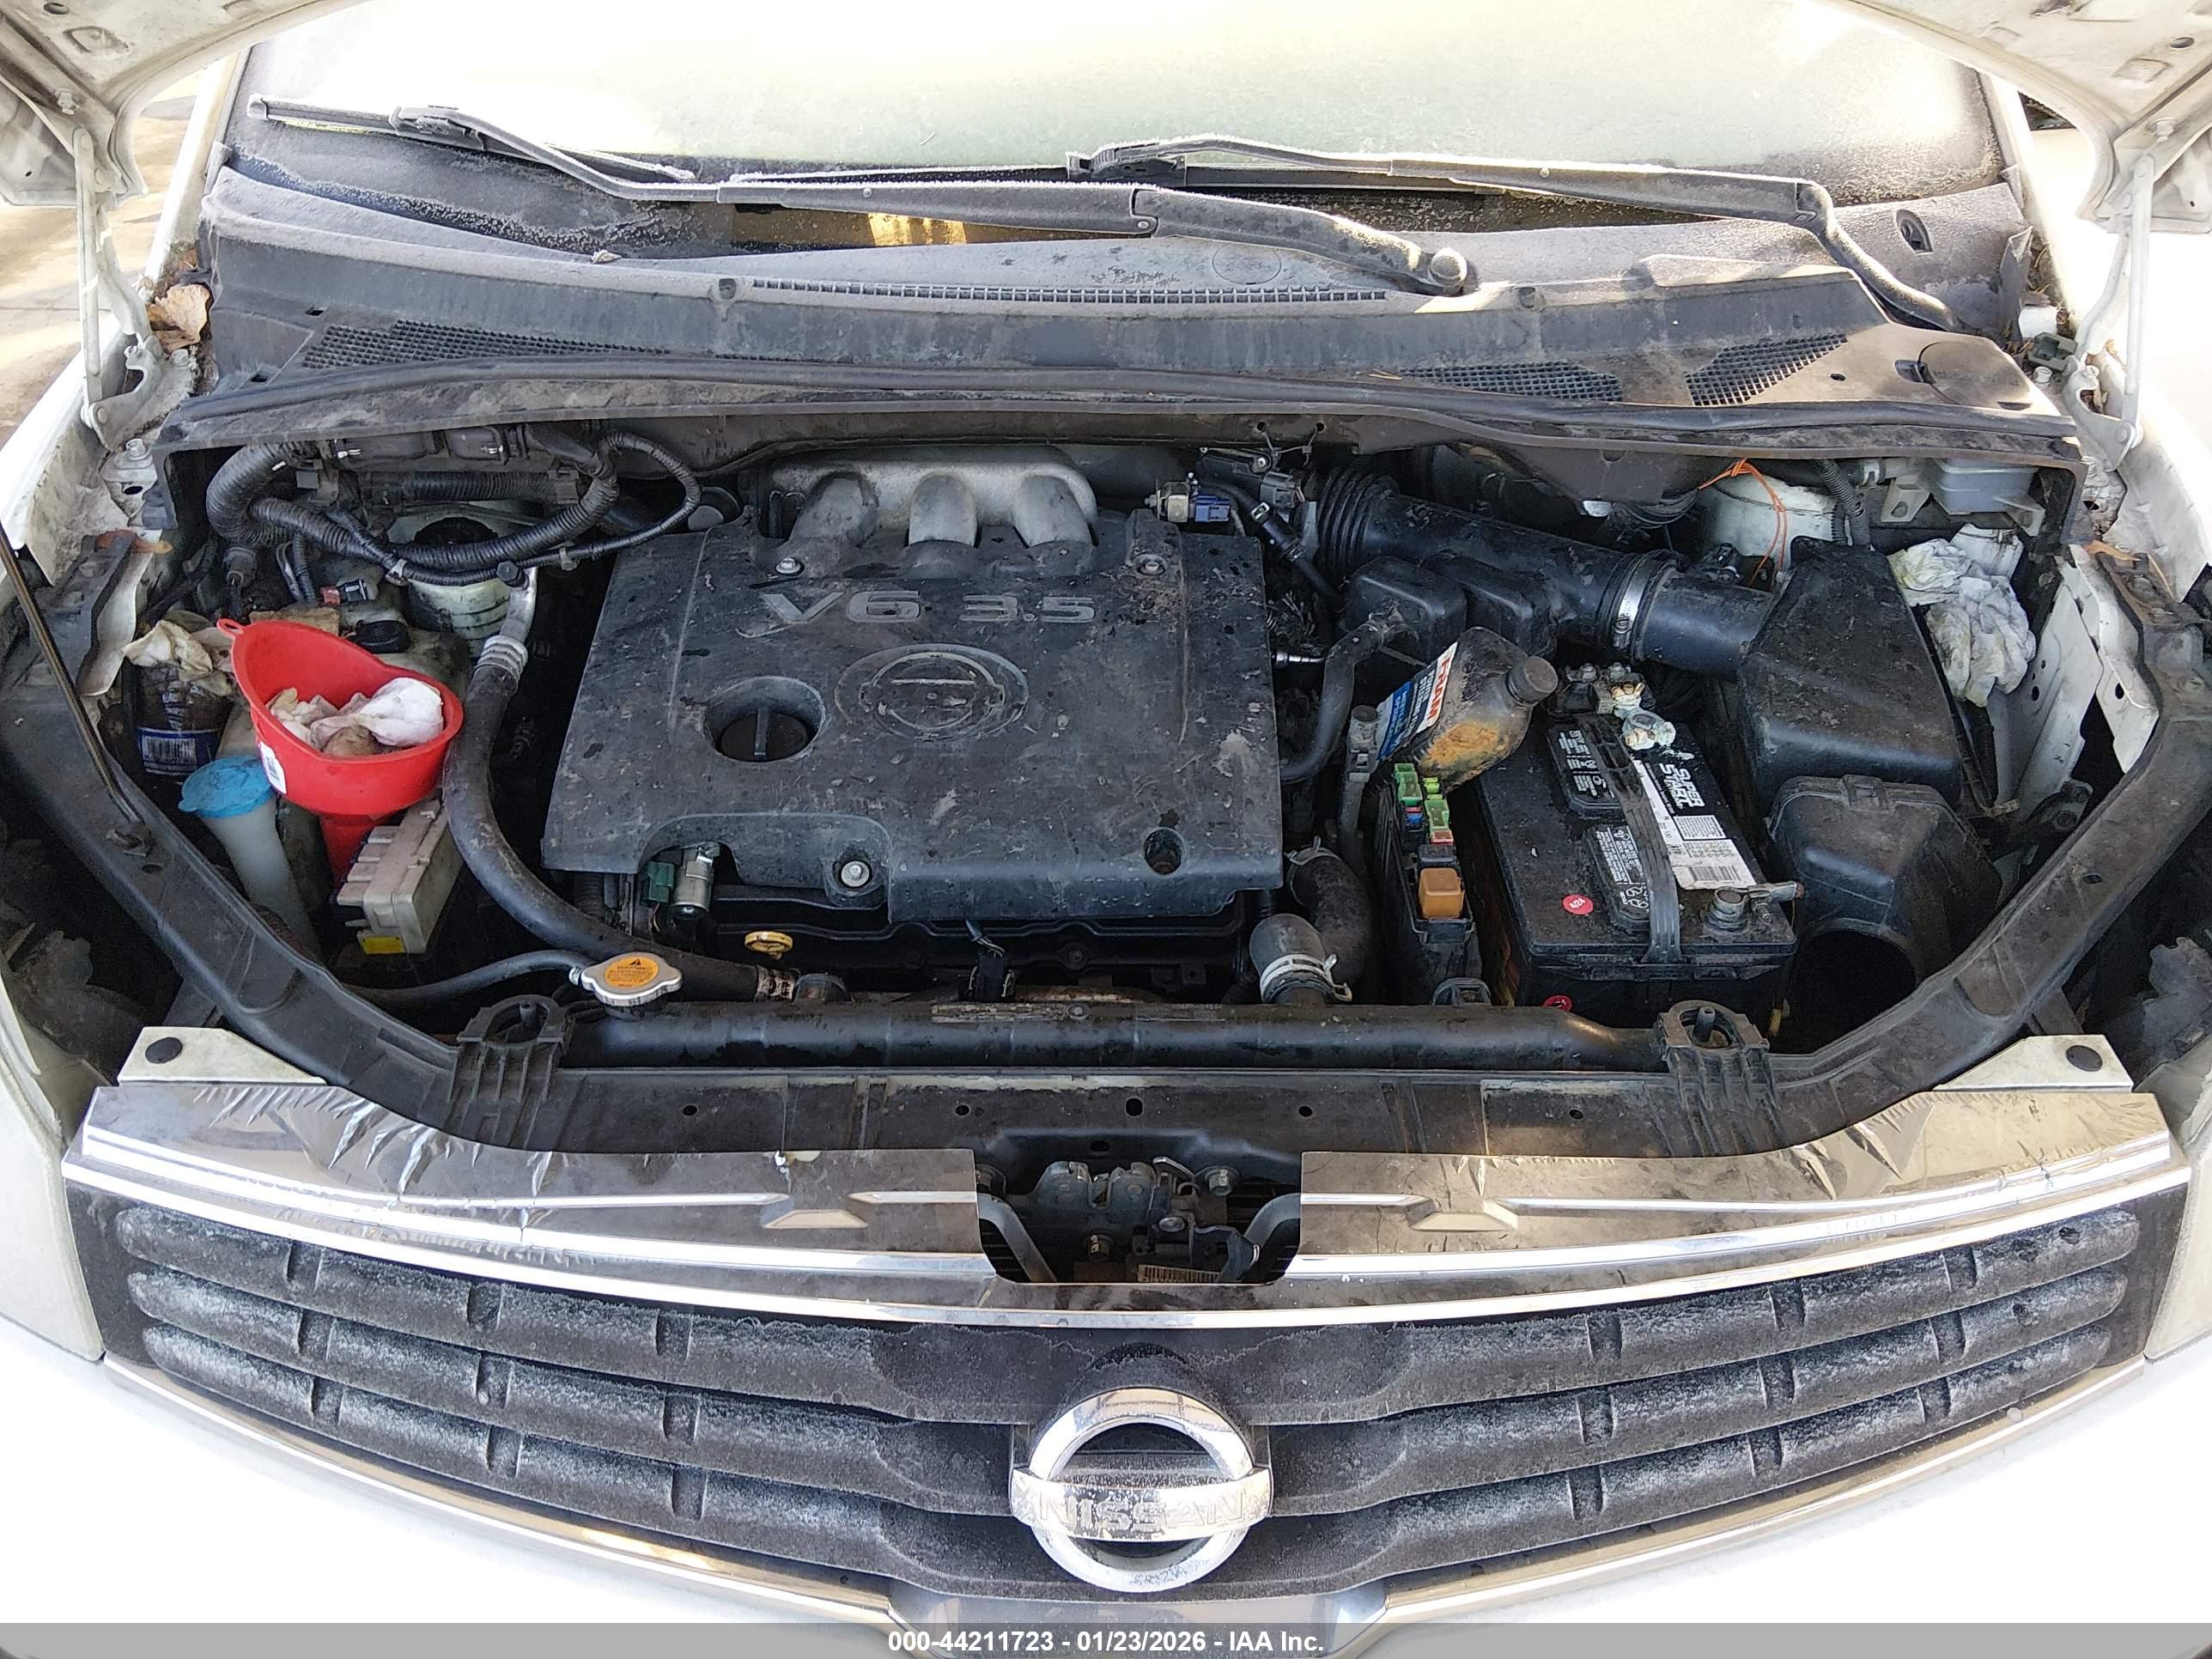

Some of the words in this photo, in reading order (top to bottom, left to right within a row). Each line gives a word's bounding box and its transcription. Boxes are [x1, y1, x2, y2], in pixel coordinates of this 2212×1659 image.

[762, 590, 921, 623] V6
[959, 594, 1097, 623] 3.5
[1427, 657, 1451, 720] FRAM
[1658, 763, 1693, 808] START
[1674, 768, 1705, 808] SUPER
[1039, 1488, 1245, 1531] NISSAN
